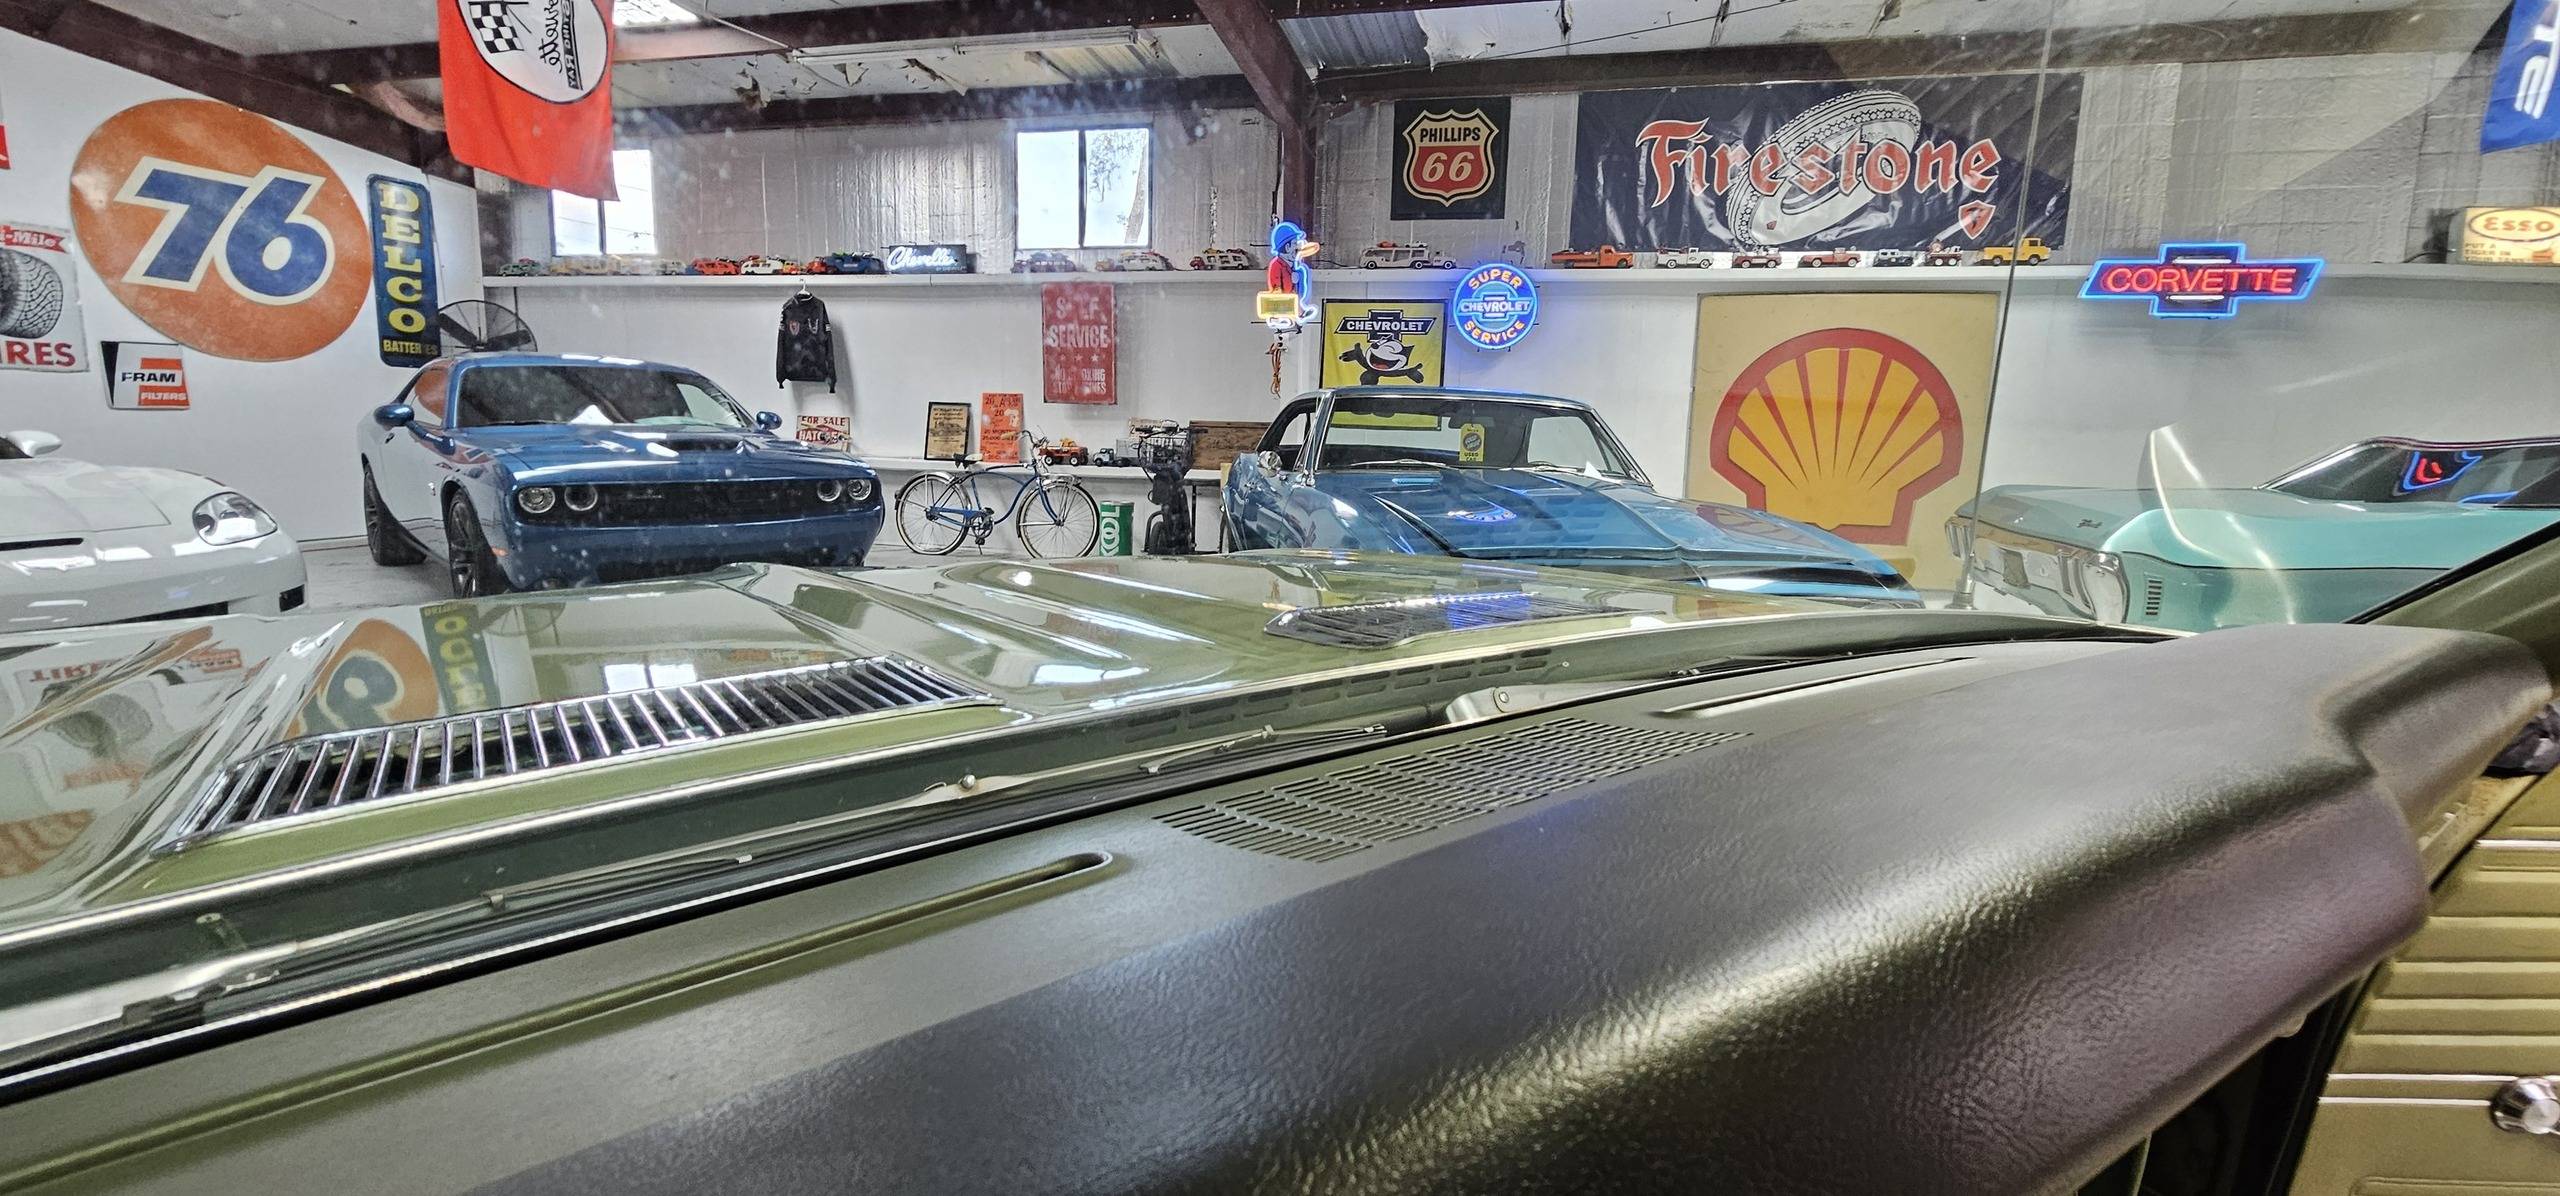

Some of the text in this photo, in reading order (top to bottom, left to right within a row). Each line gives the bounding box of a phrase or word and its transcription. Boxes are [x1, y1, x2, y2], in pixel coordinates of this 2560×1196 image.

[1420, 127, 1481, 142] PHILLIPS
[1422, 151, 1474, 182] 66
[1635, 117, 2001, 208] Firestone
[114, 155, 335, 305] 76
[379, 182, 427, 334] DELCO
[1468, 269, 1523, 289] SUPER
[2101, 266, 2297, 295] CORVETTE
[1055, 297, 1099, 320] SLF
[1460, 300, 1531, 313] CHEVROLET
[1045, 324, 1109, 348] SERVICE
[1346, 321, 1425, 332] CHEVROLET
[1464, 319, 1525, 344] SERVICE
[0, 340, 76, 367] RES
[121, 372, 176, 384] FRAM
[140, 391, 187, 401] FILTERS
[801, 415, 846, 426] FOR SALE
